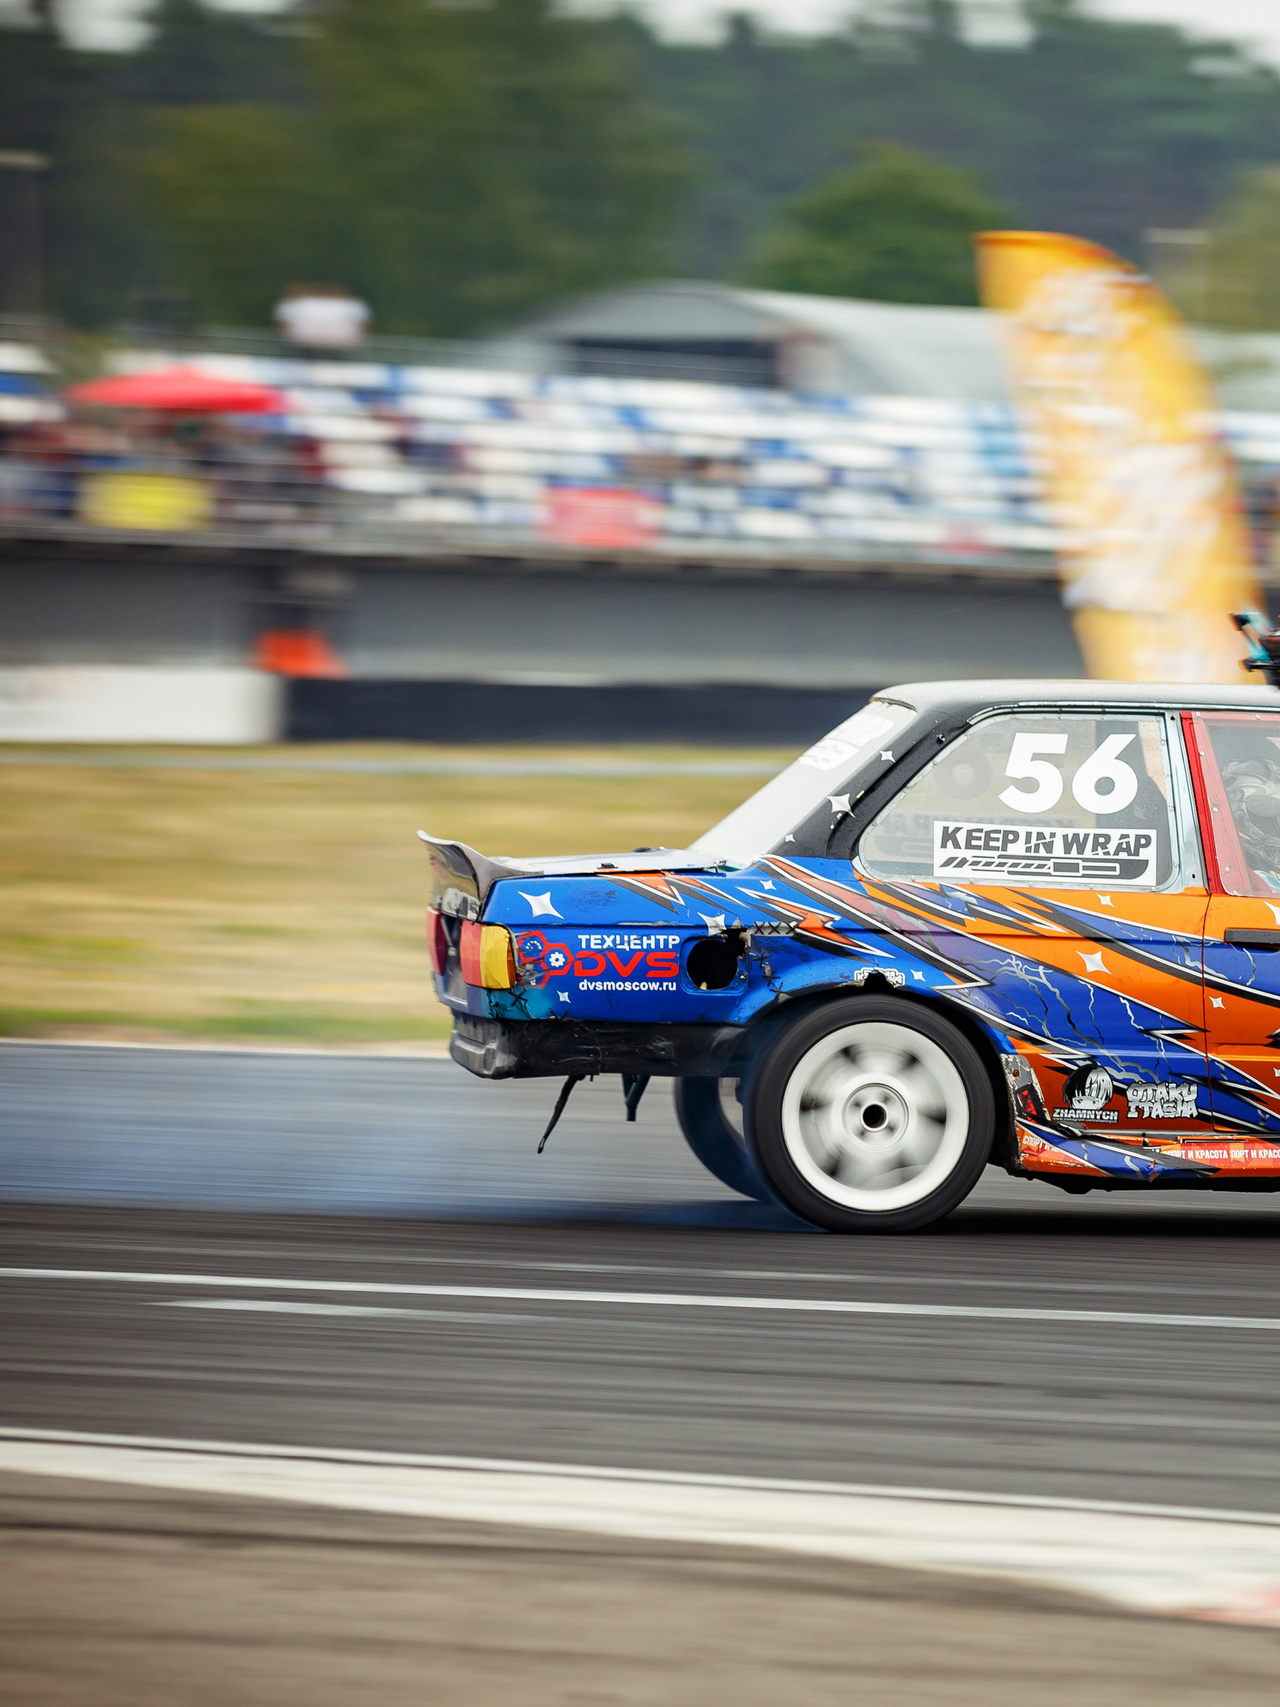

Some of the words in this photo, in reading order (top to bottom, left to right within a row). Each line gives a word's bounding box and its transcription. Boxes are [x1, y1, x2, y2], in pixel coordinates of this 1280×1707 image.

[998, 733, 1138, 814] 56
[940, 826, 1020, 852] KEEP
[1024, 831, 1056, 854] IN
[1062, 833, 1152, 857] WRAP
[577, 934, 681, 951] ТЕХЦЕНТР
[573, 951, 680, 978] DVS
[578, 979, 677, 991] dvsmoscow.ru
[1126, 1081, 1197, 1103] OTAKU
[1052, 1108, 1118, 1120] ZHAMNYCH
[1187, 1150, 1194, 1159] И
[1195, 1149, 1229, 1159] КРАСОТА
[1250, 1149, 1257, 1159] И
